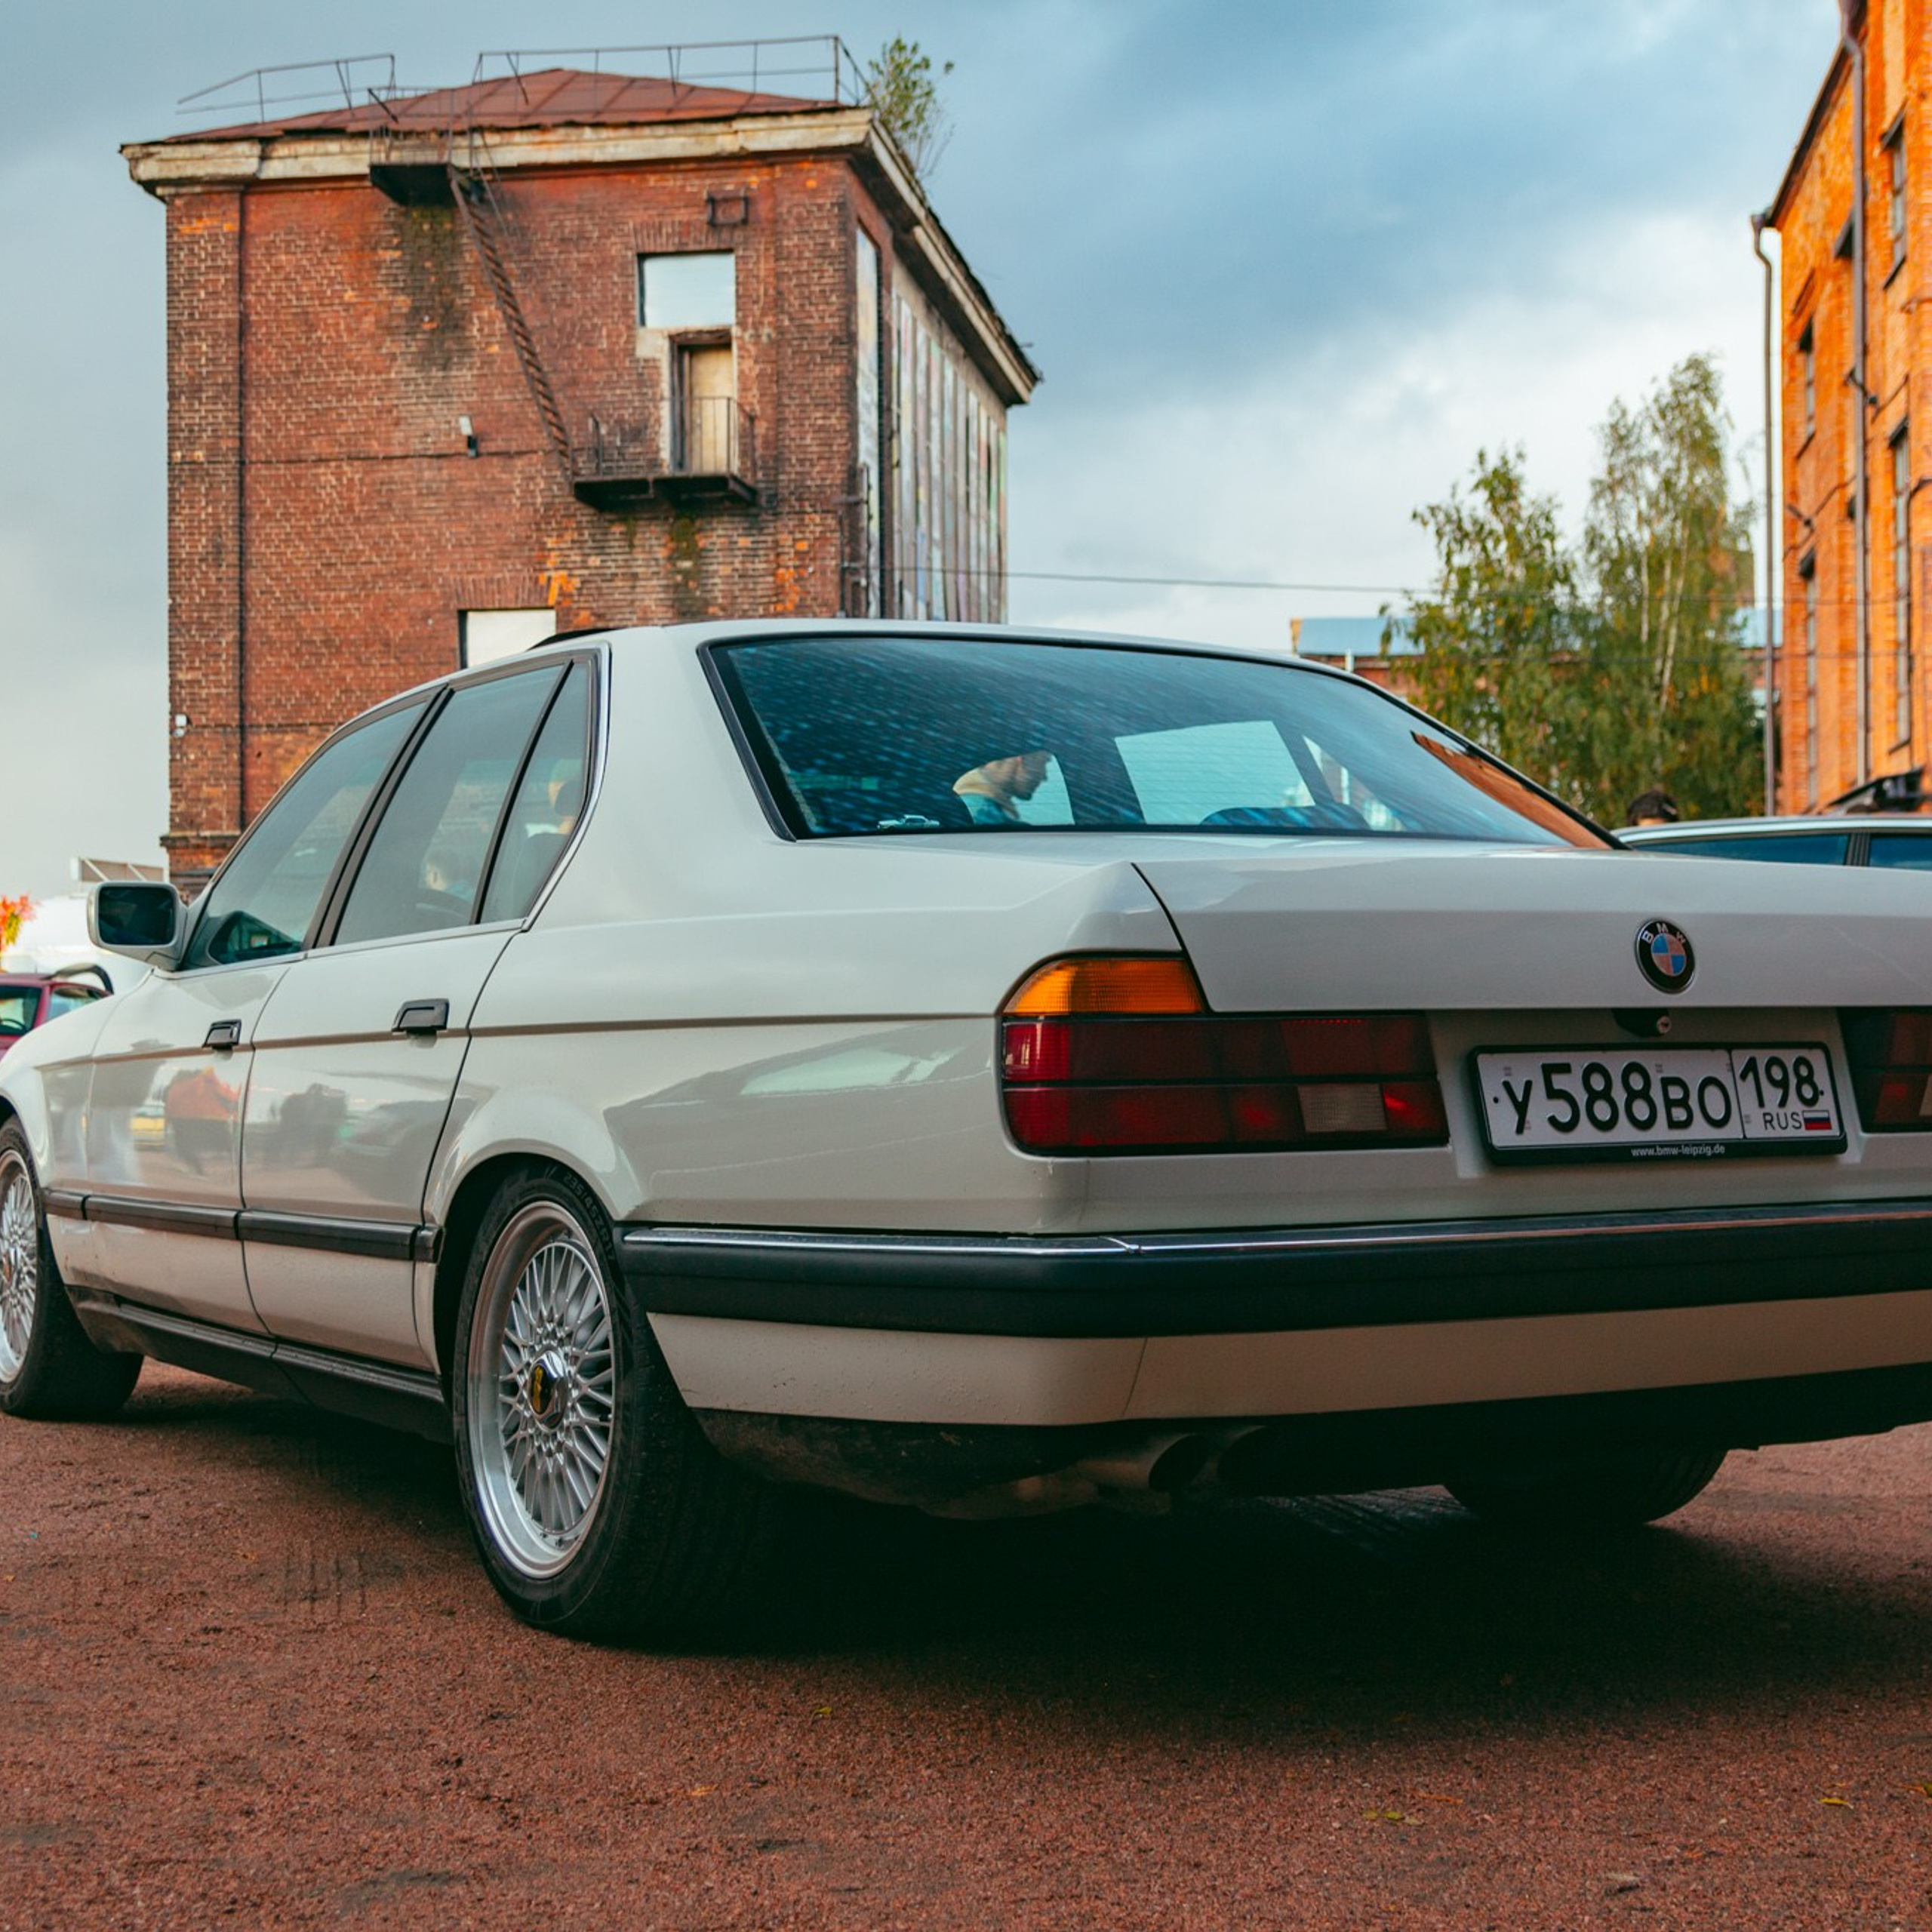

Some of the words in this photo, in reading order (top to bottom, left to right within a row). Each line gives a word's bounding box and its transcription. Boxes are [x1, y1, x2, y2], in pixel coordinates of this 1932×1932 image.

[1641, 922, 1686, 944] BMW
[1740, 1056, 1820, 1109] 198
[1762, 1112, 1802, 1131] RUS
[1631, 1143, 1725, 1156] www.bmw-leipzig.de
